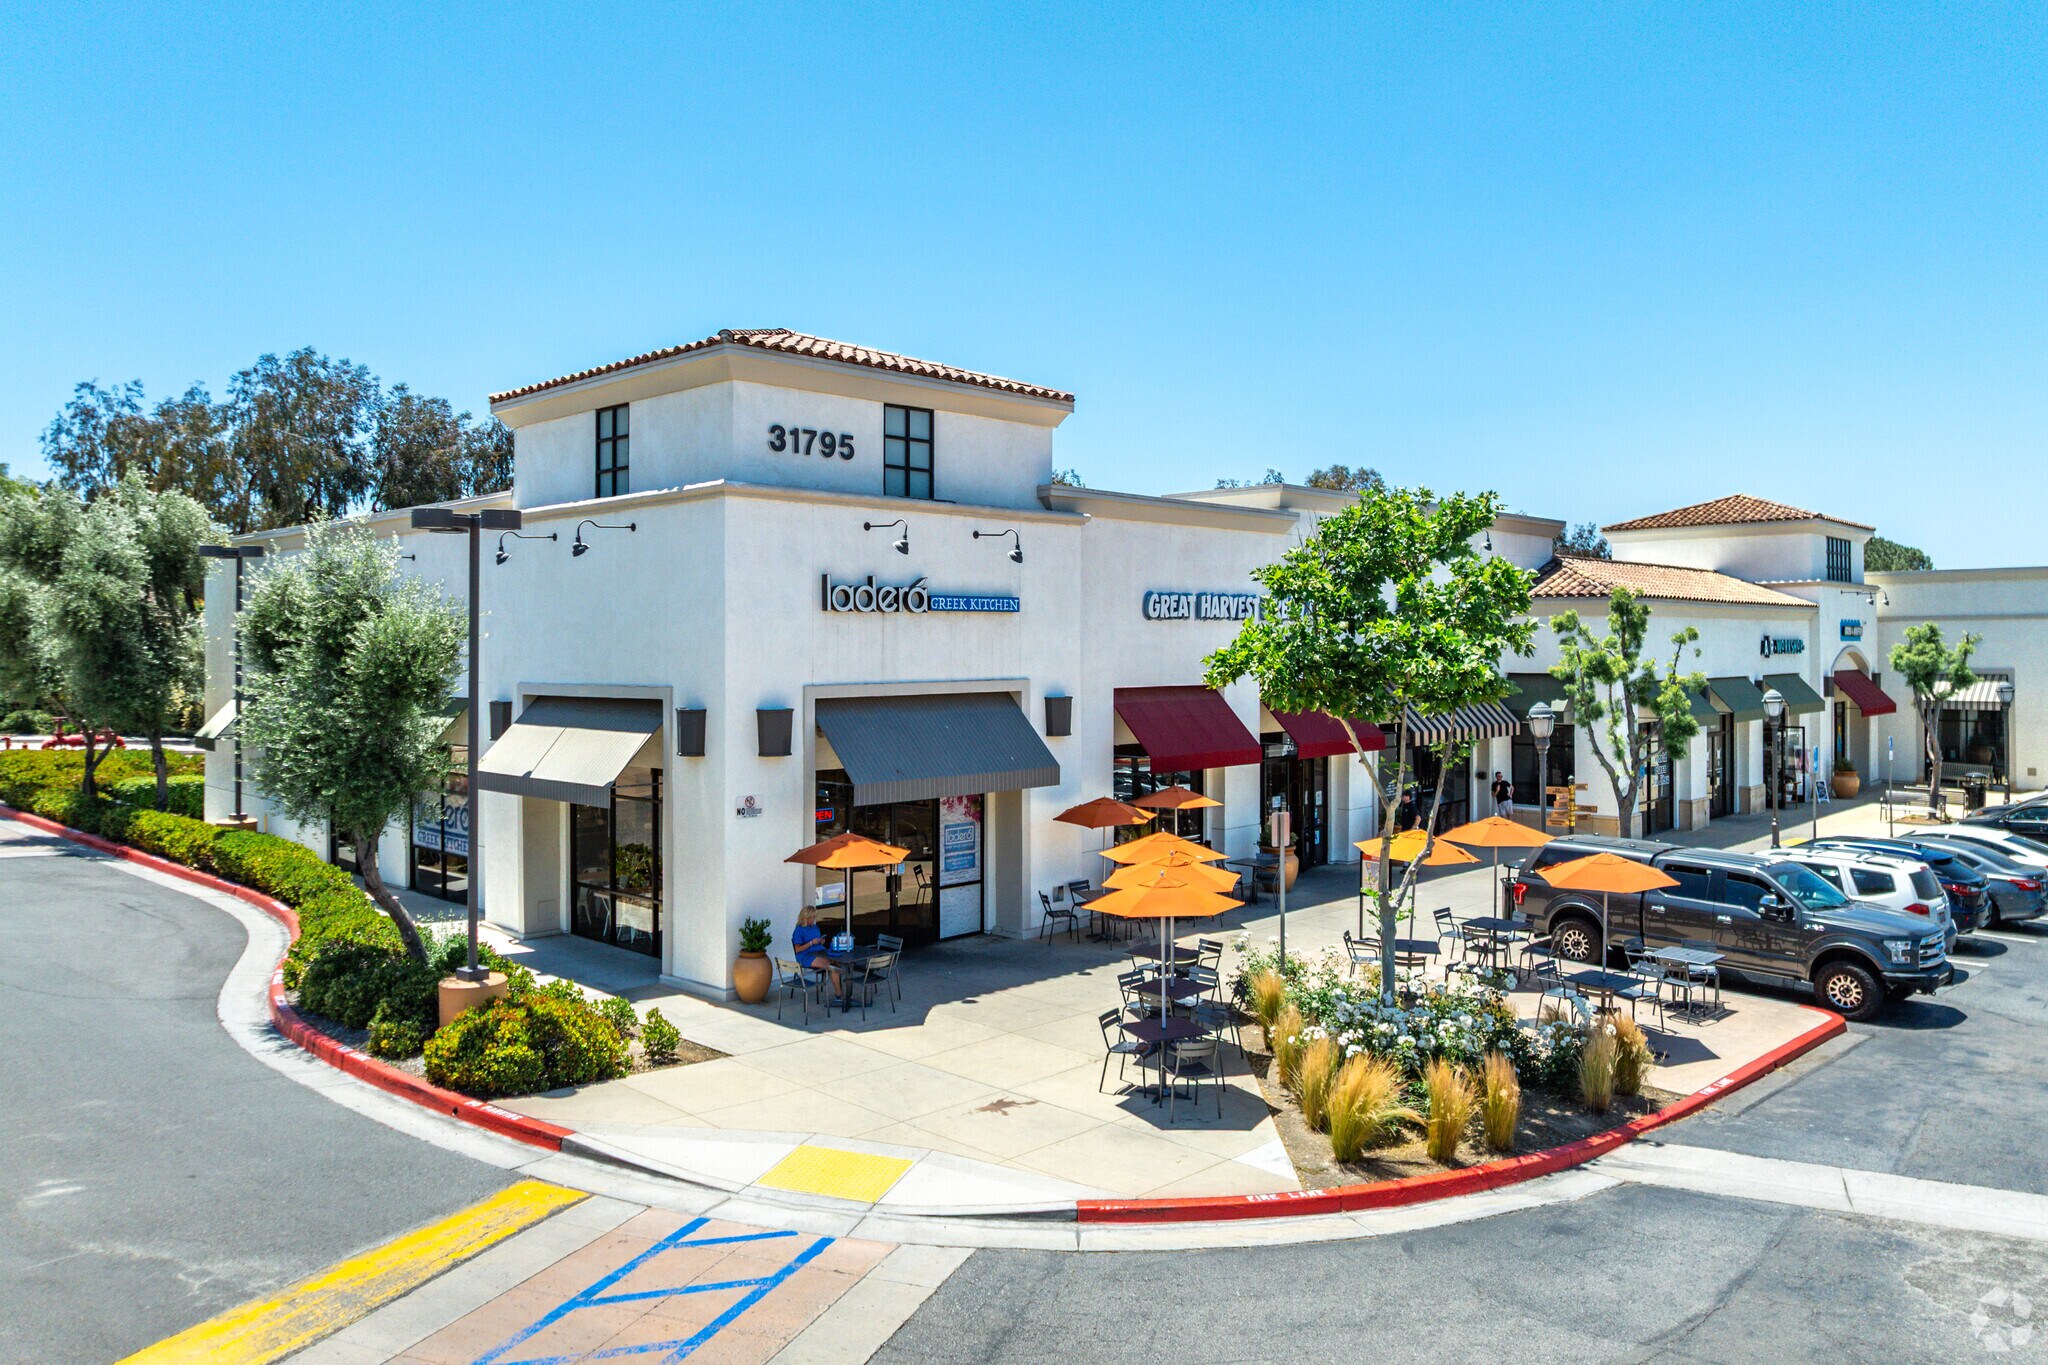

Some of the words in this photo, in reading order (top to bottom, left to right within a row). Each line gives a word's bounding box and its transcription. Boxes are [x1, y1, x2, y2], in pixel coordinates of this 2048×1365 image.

[768, 424, 855, 461] 31795
[930, 597, 967, 611] GREEK
[969, 598, 1019, 611] KITCHEN
[1147, 592, 1196, 619] GREAT
[1201, 593, 1261, 620] HARVEST
[737, 807, 745, 815] NO
[418, 830, 440, 847] GREEK
[1246, 1193, 1280, 1203] FIRE
[1287, 1189, 1327, 1199] LANE
